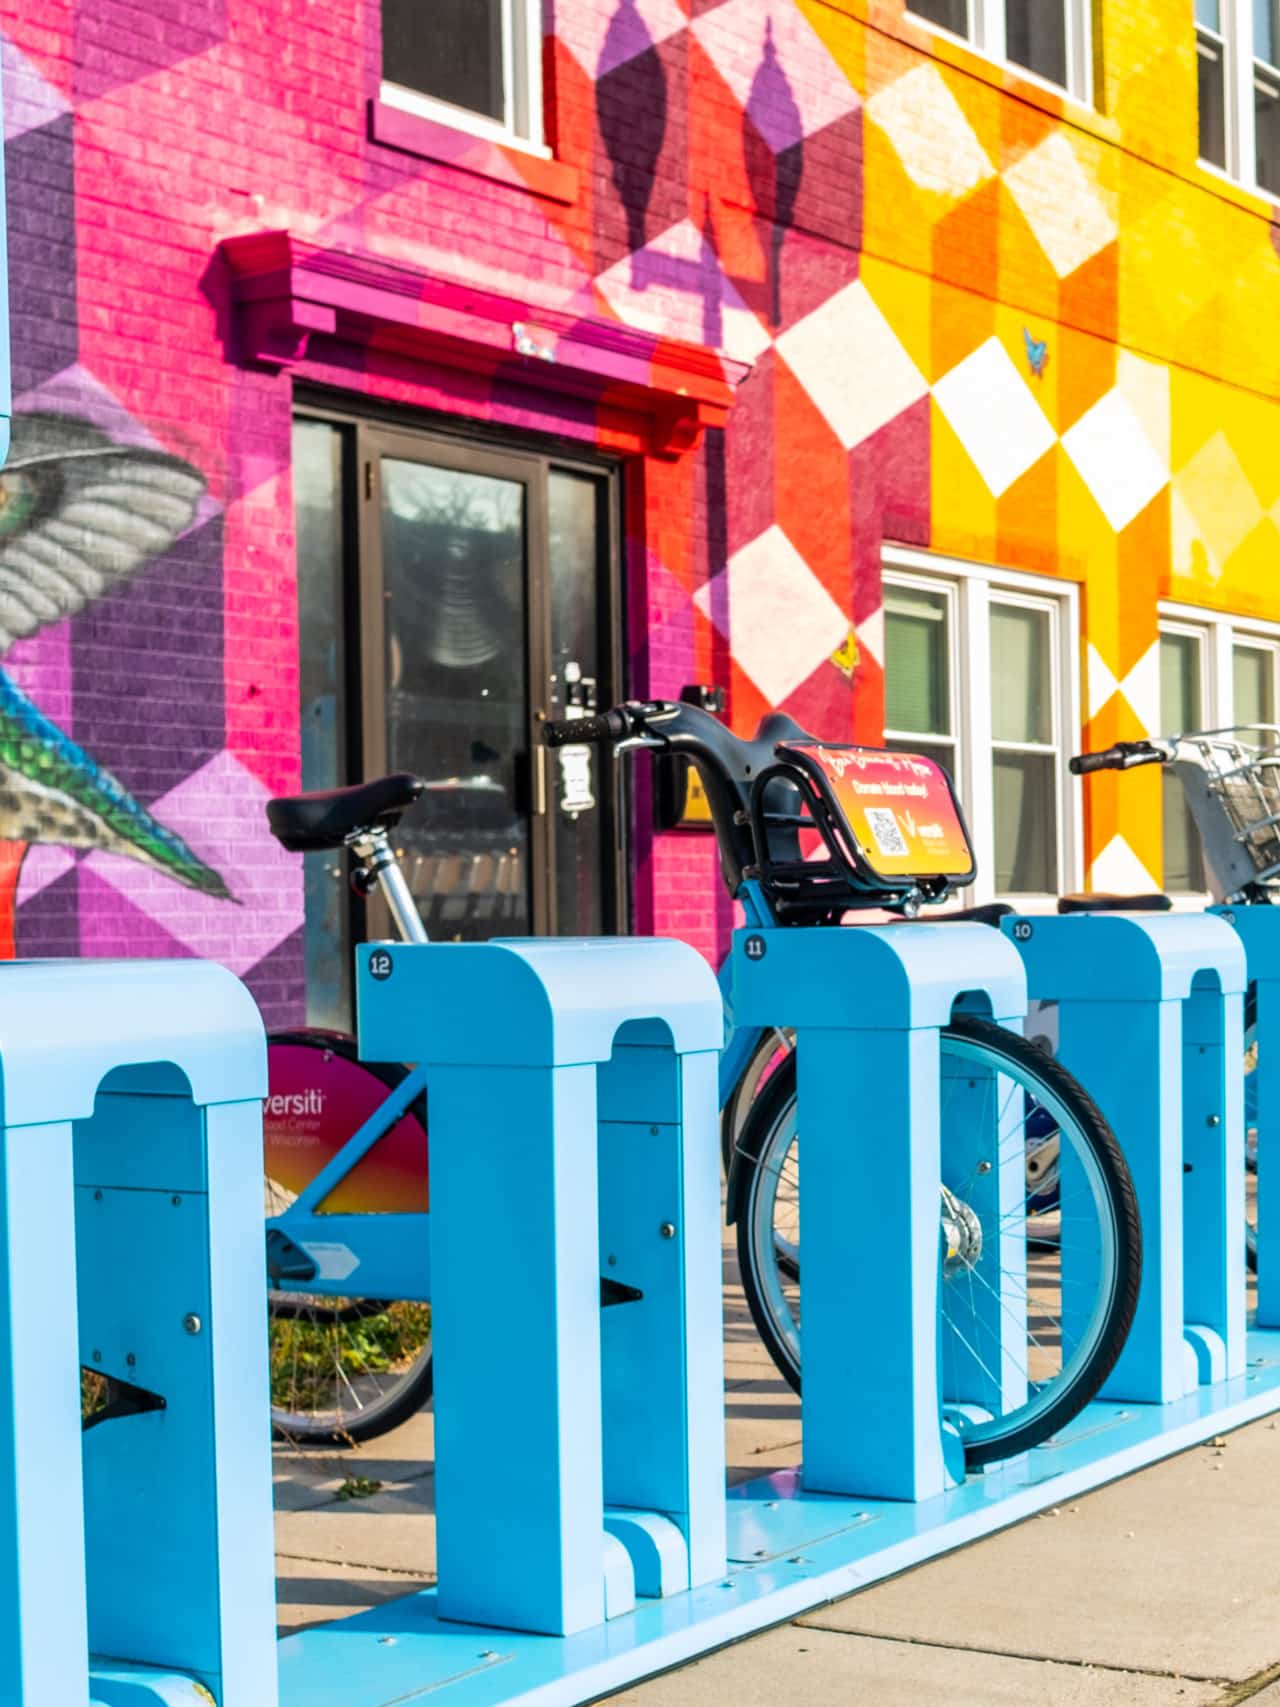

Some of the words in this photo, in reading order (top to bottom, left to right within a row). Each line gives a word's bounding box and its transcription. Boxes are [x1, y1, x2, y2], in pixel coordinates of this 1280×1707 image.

[1015, 924, 1031, 938] 10
[748, 940, 763, 955] 11
[371, 956, 390, 974] 12
